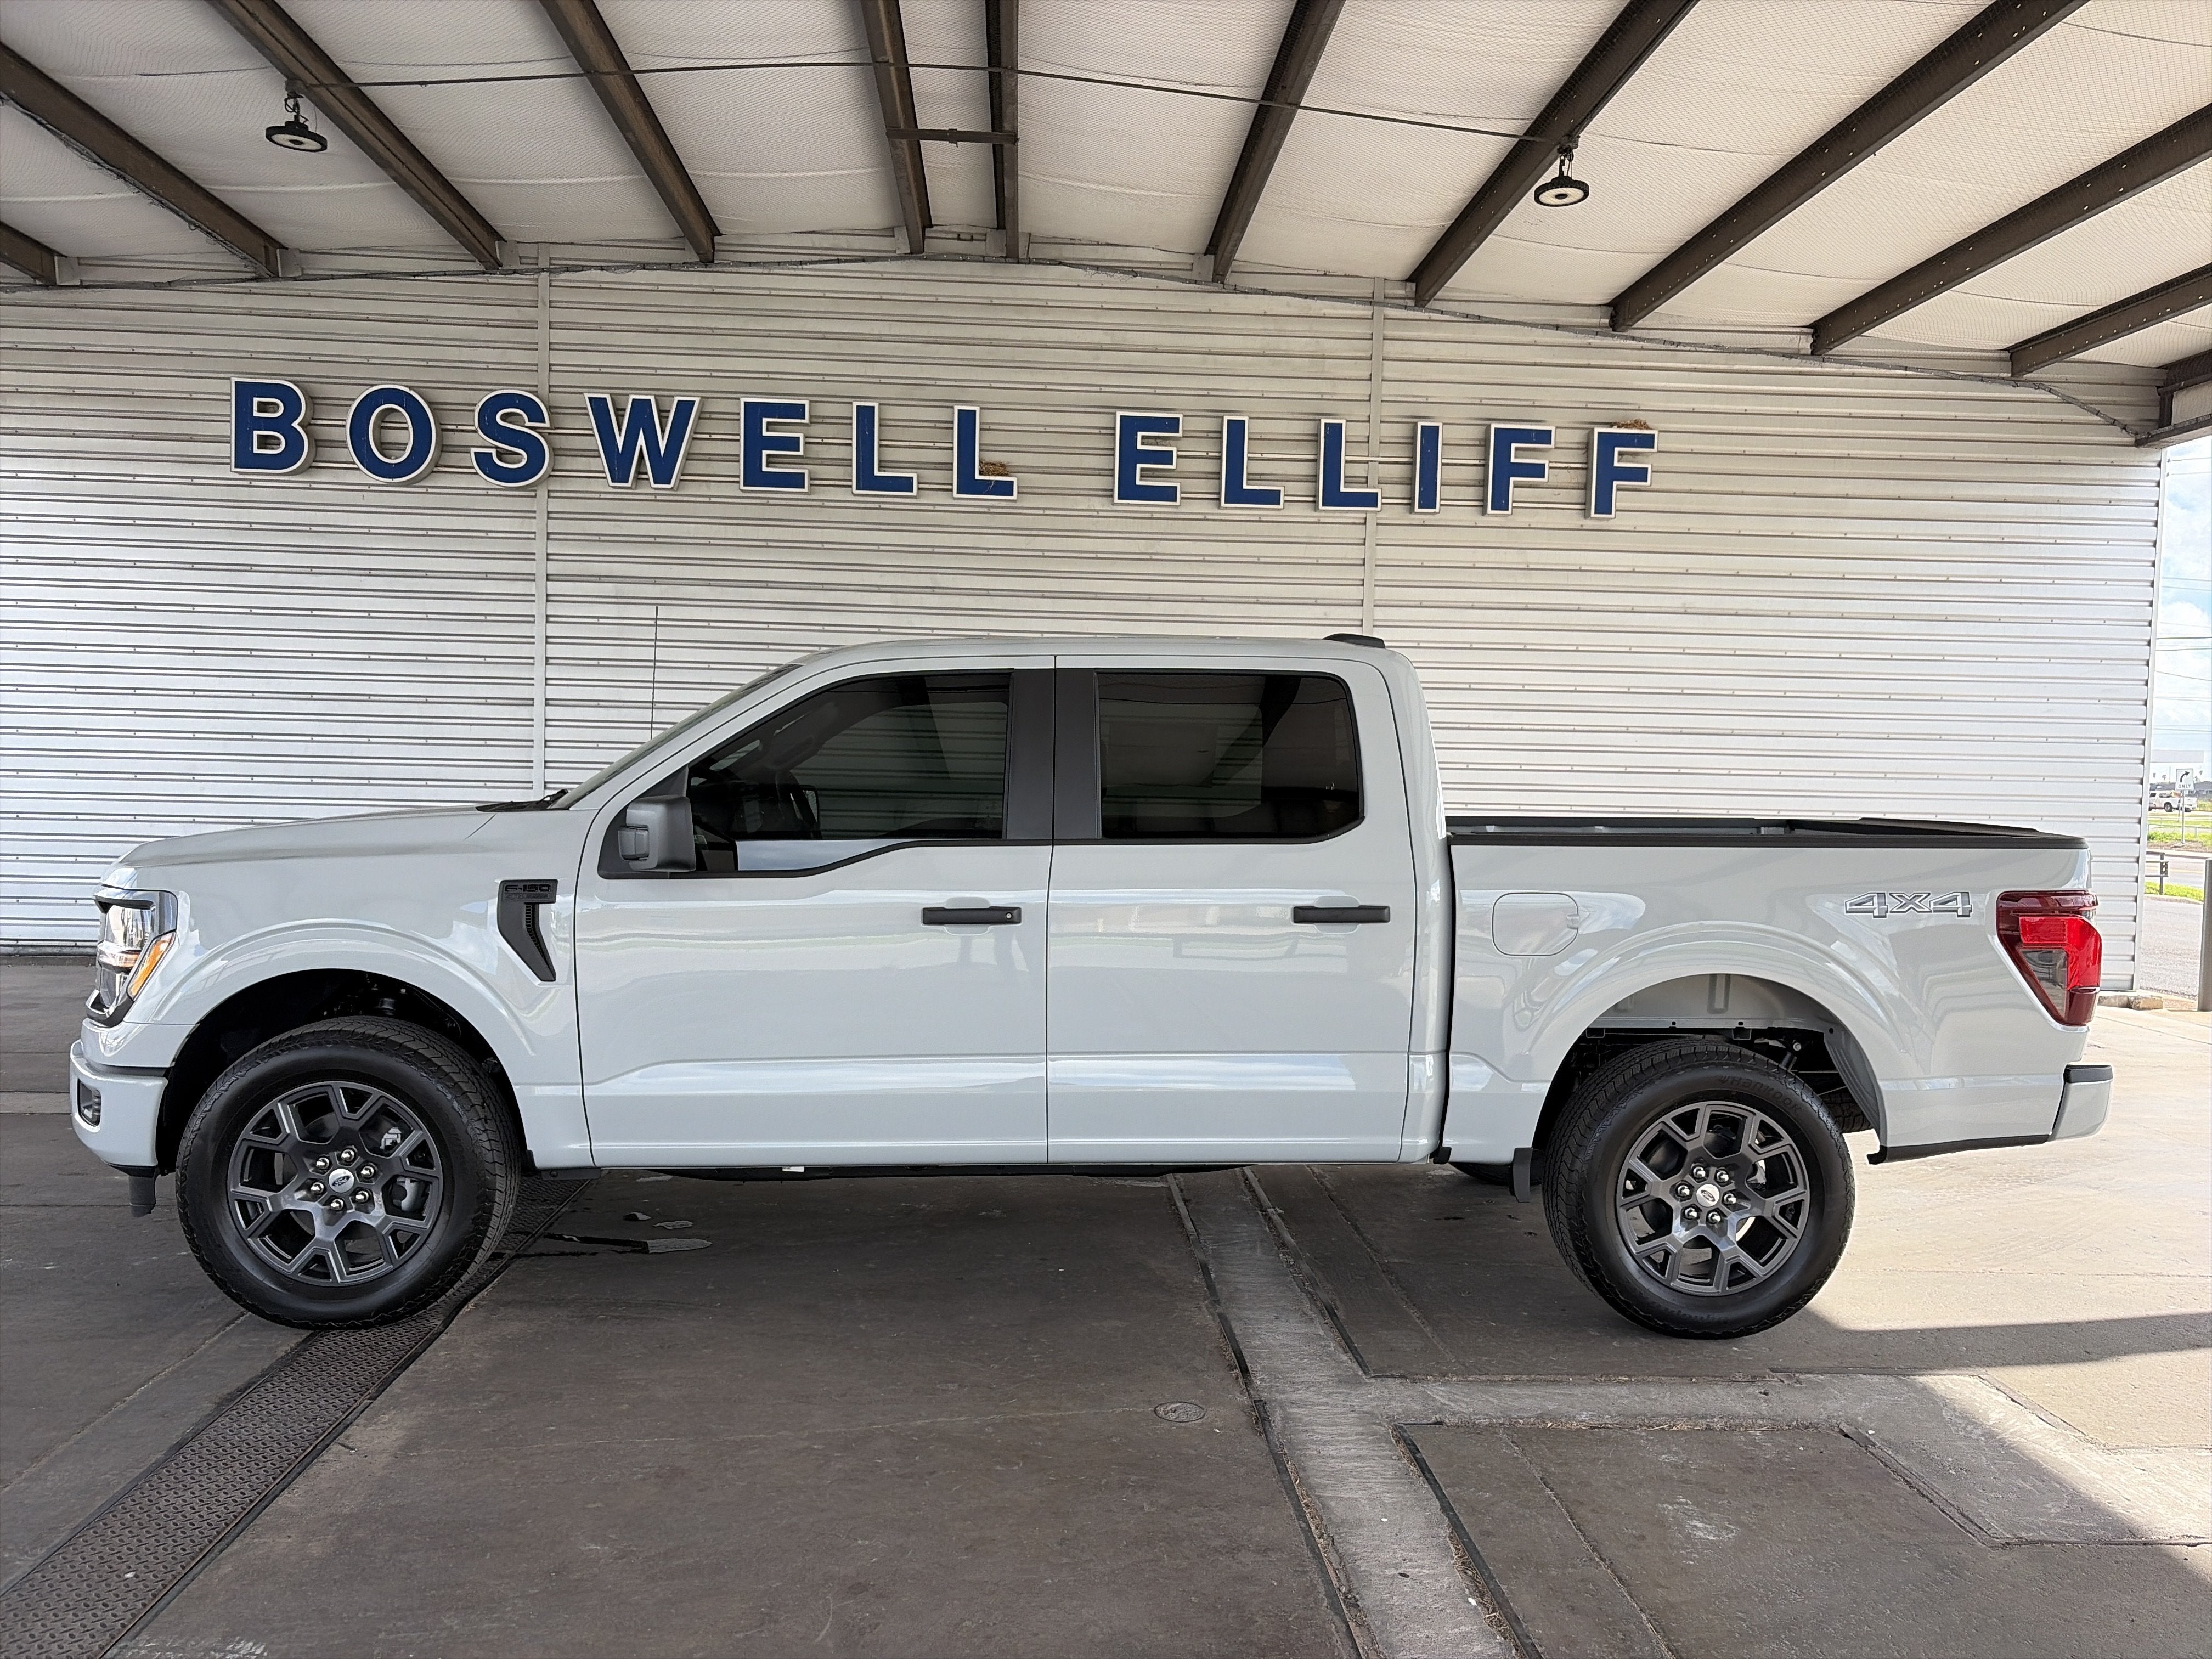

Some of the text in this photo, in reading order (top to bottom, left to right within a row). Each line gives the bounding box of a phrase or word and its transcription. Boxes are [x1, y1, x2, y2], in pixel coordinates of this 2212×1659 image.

[230, 377, 1658, 518] BOSWELL ELLIFF
[504, 884, 551, 893] F-150
[333, 1176, 349, 1186] Ford
